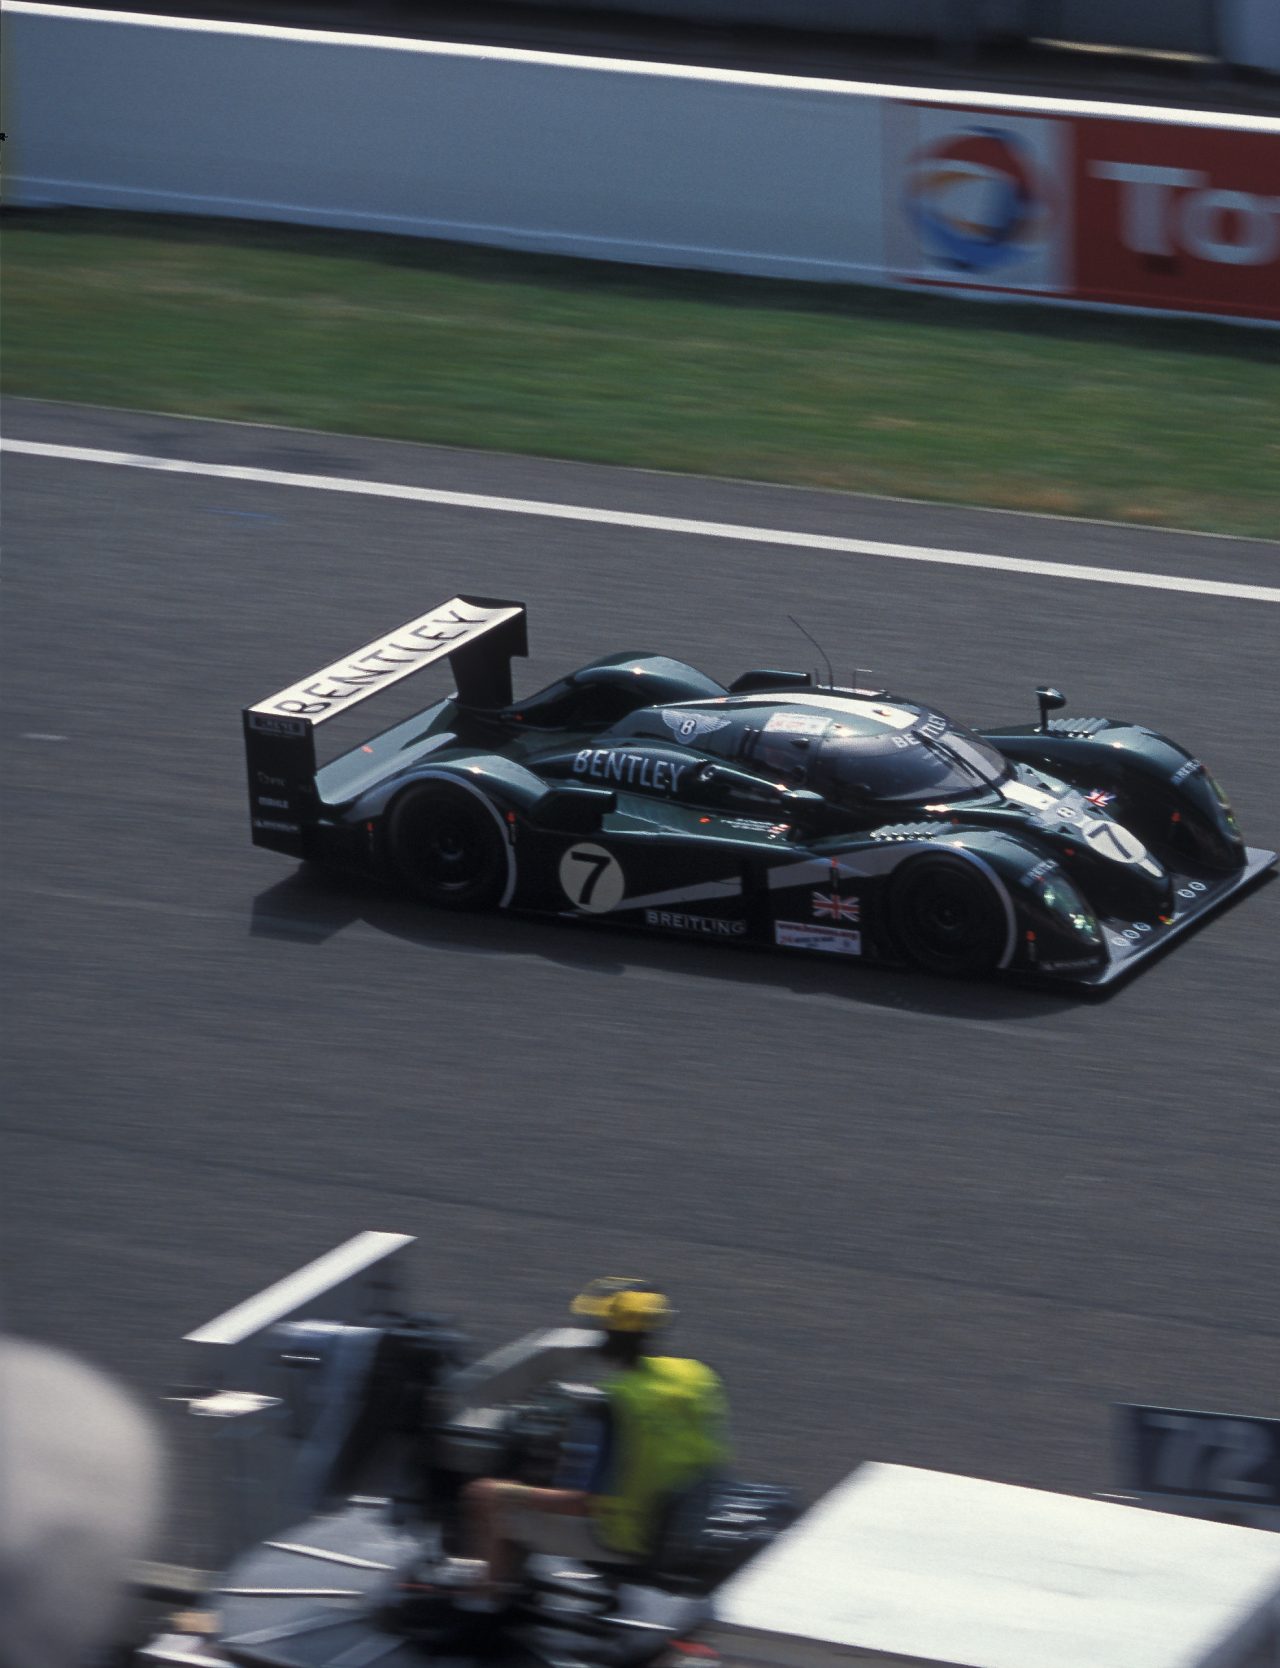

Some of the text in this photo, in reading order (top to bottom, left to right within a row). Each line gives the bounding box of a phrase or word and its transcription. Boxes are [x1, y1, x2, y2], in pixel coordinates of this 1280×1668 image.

[276, 610, 487, 716] BENTLEY
[573, 748, 685, 793] BENTLEY
[1087, 823, 1131, 856] 7
[571, 851, 612, 906] 7
[646, 910, 747, 936] BREITLING
